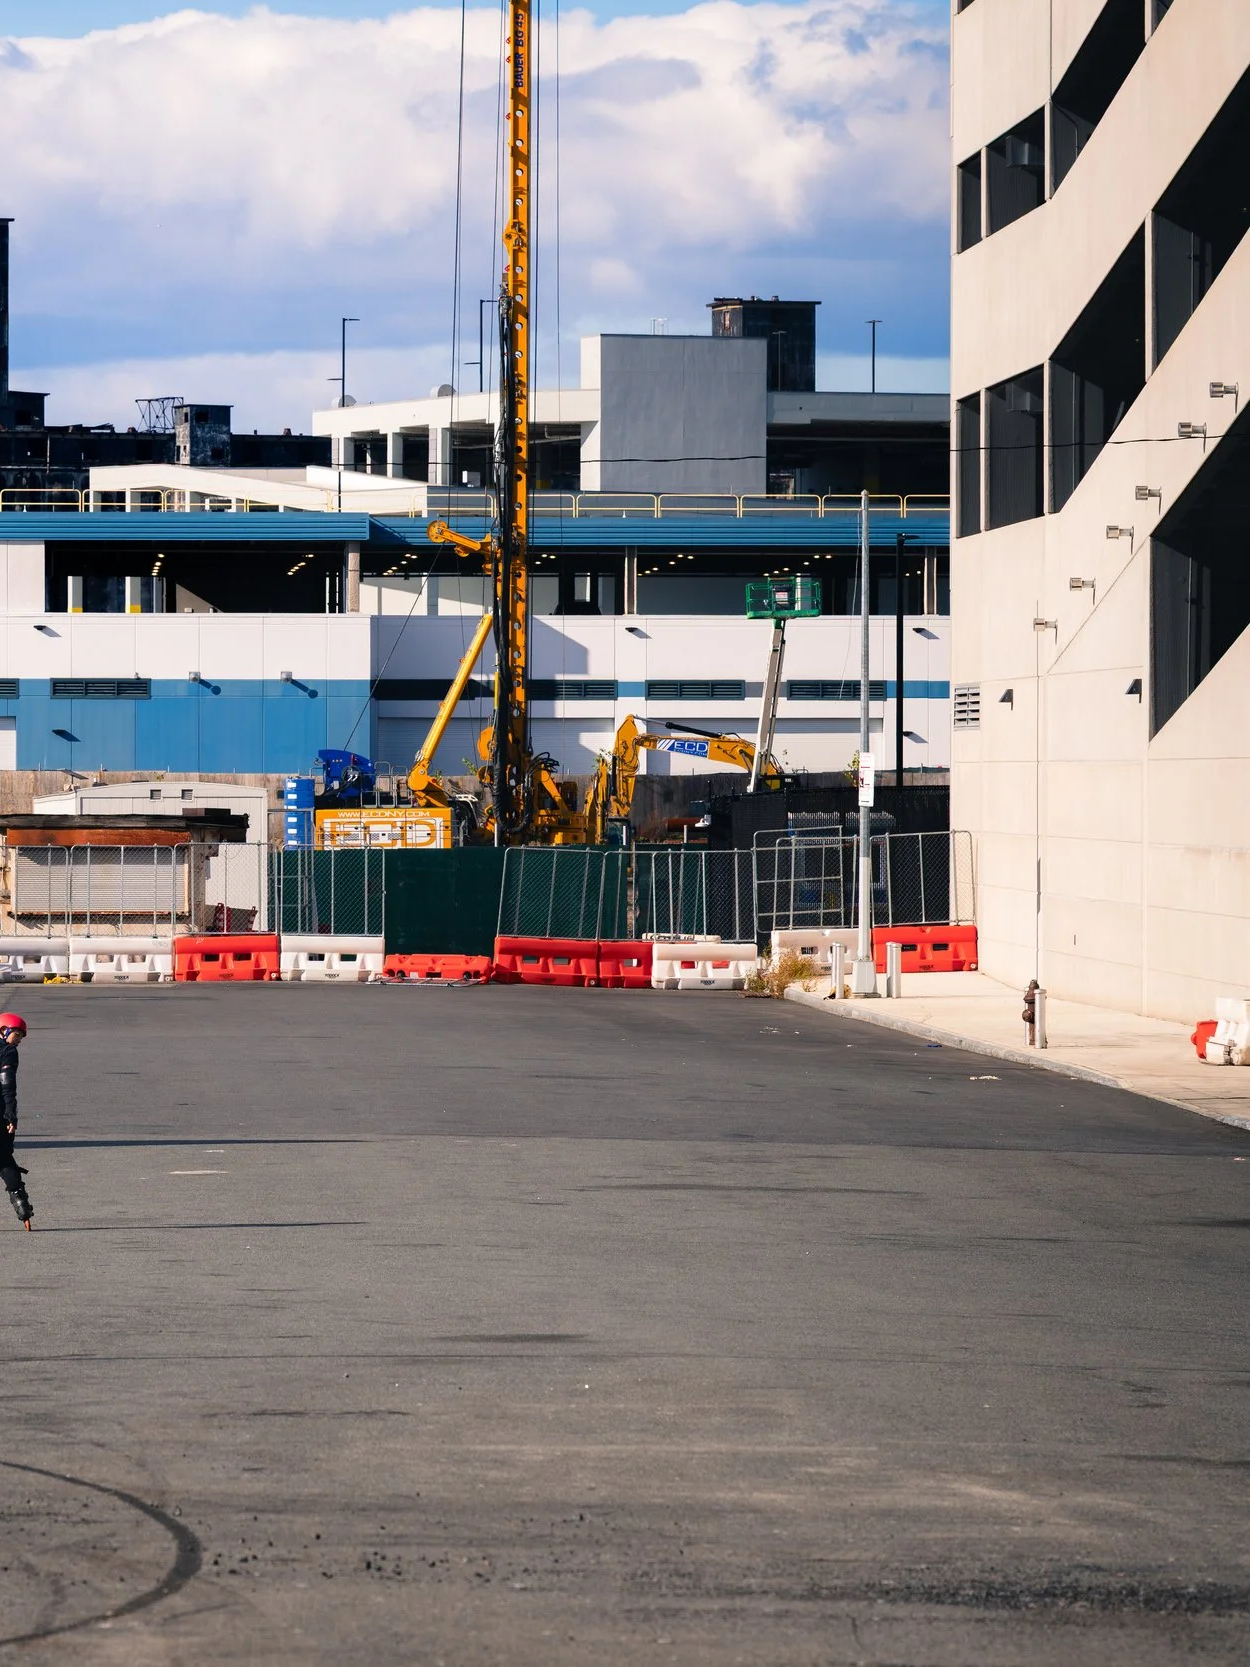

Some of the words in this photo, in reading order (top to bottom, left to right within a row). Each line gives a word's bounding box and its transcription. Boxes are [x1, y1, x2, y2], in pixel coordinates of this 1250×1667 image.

[515, 13, 524, 28] 45
[515, 30, 524, 47] BG
[514, 53, 524, 87] BAUER
[674, 741, 708, 753] ECD
